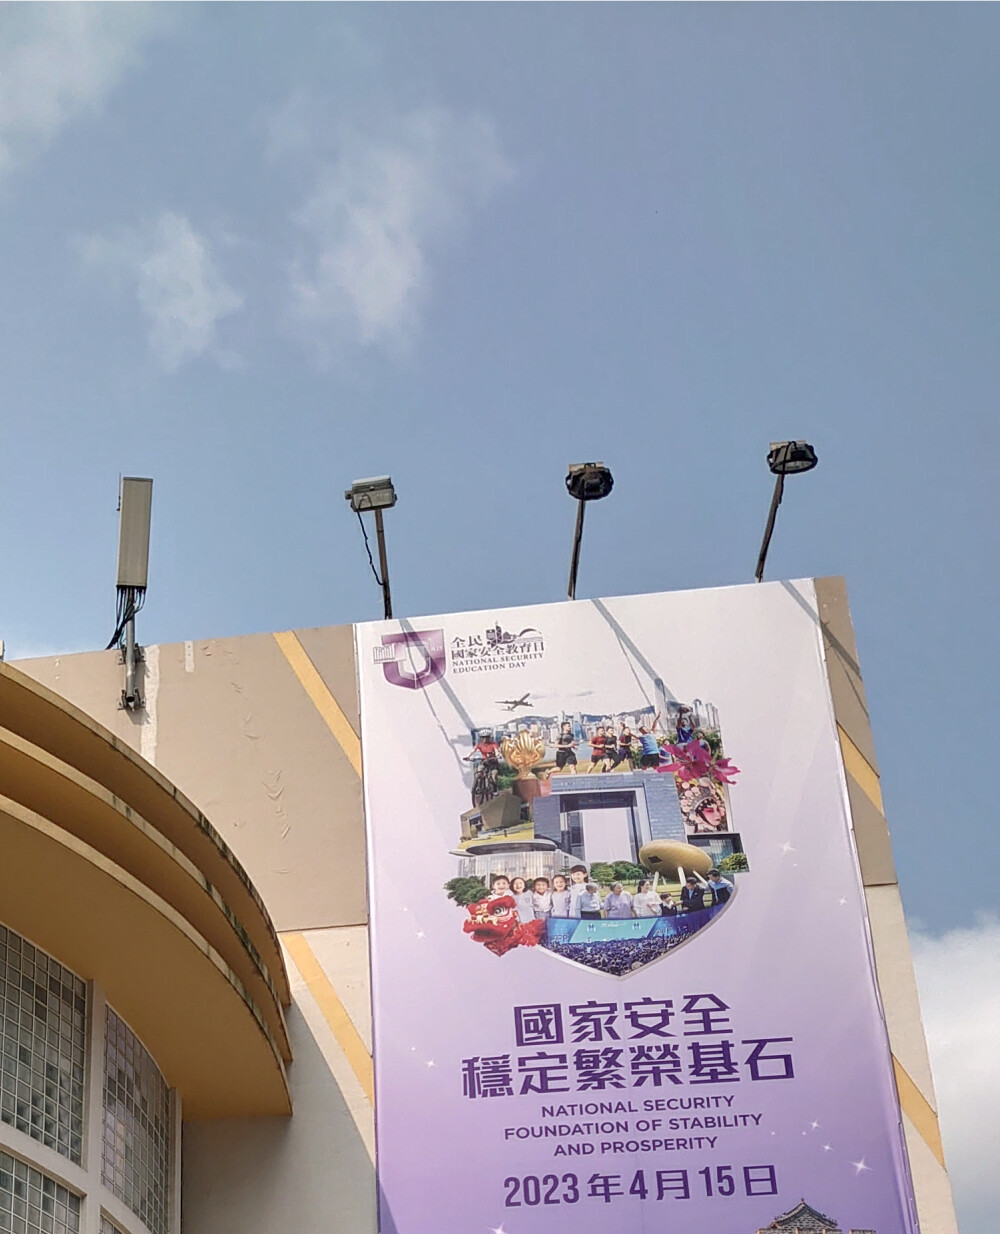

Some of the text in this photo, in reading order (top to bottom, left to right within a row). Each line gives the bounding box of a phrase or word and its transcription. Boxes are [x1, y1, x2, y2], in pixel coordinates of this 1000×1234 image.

[451, 642, 545, 660] 國家安全教育日
[452, 635, 483, 648] 全民
[452, 652, 544, 667] NATIONAL SECURITY
[453, 664, 506, 673] EDUCATION
[514, 993, 734, 1047] 國家安全
[461, 1037, 795, 1099] 穩定繁榮基石
[541, 1095, 736, 1118] NATIONAL SECURITY
[504, 1113, 763, 1140] FOUNDATION OF STABILITY
[553, 1136, 718, 1157] AND PROSPERITY
